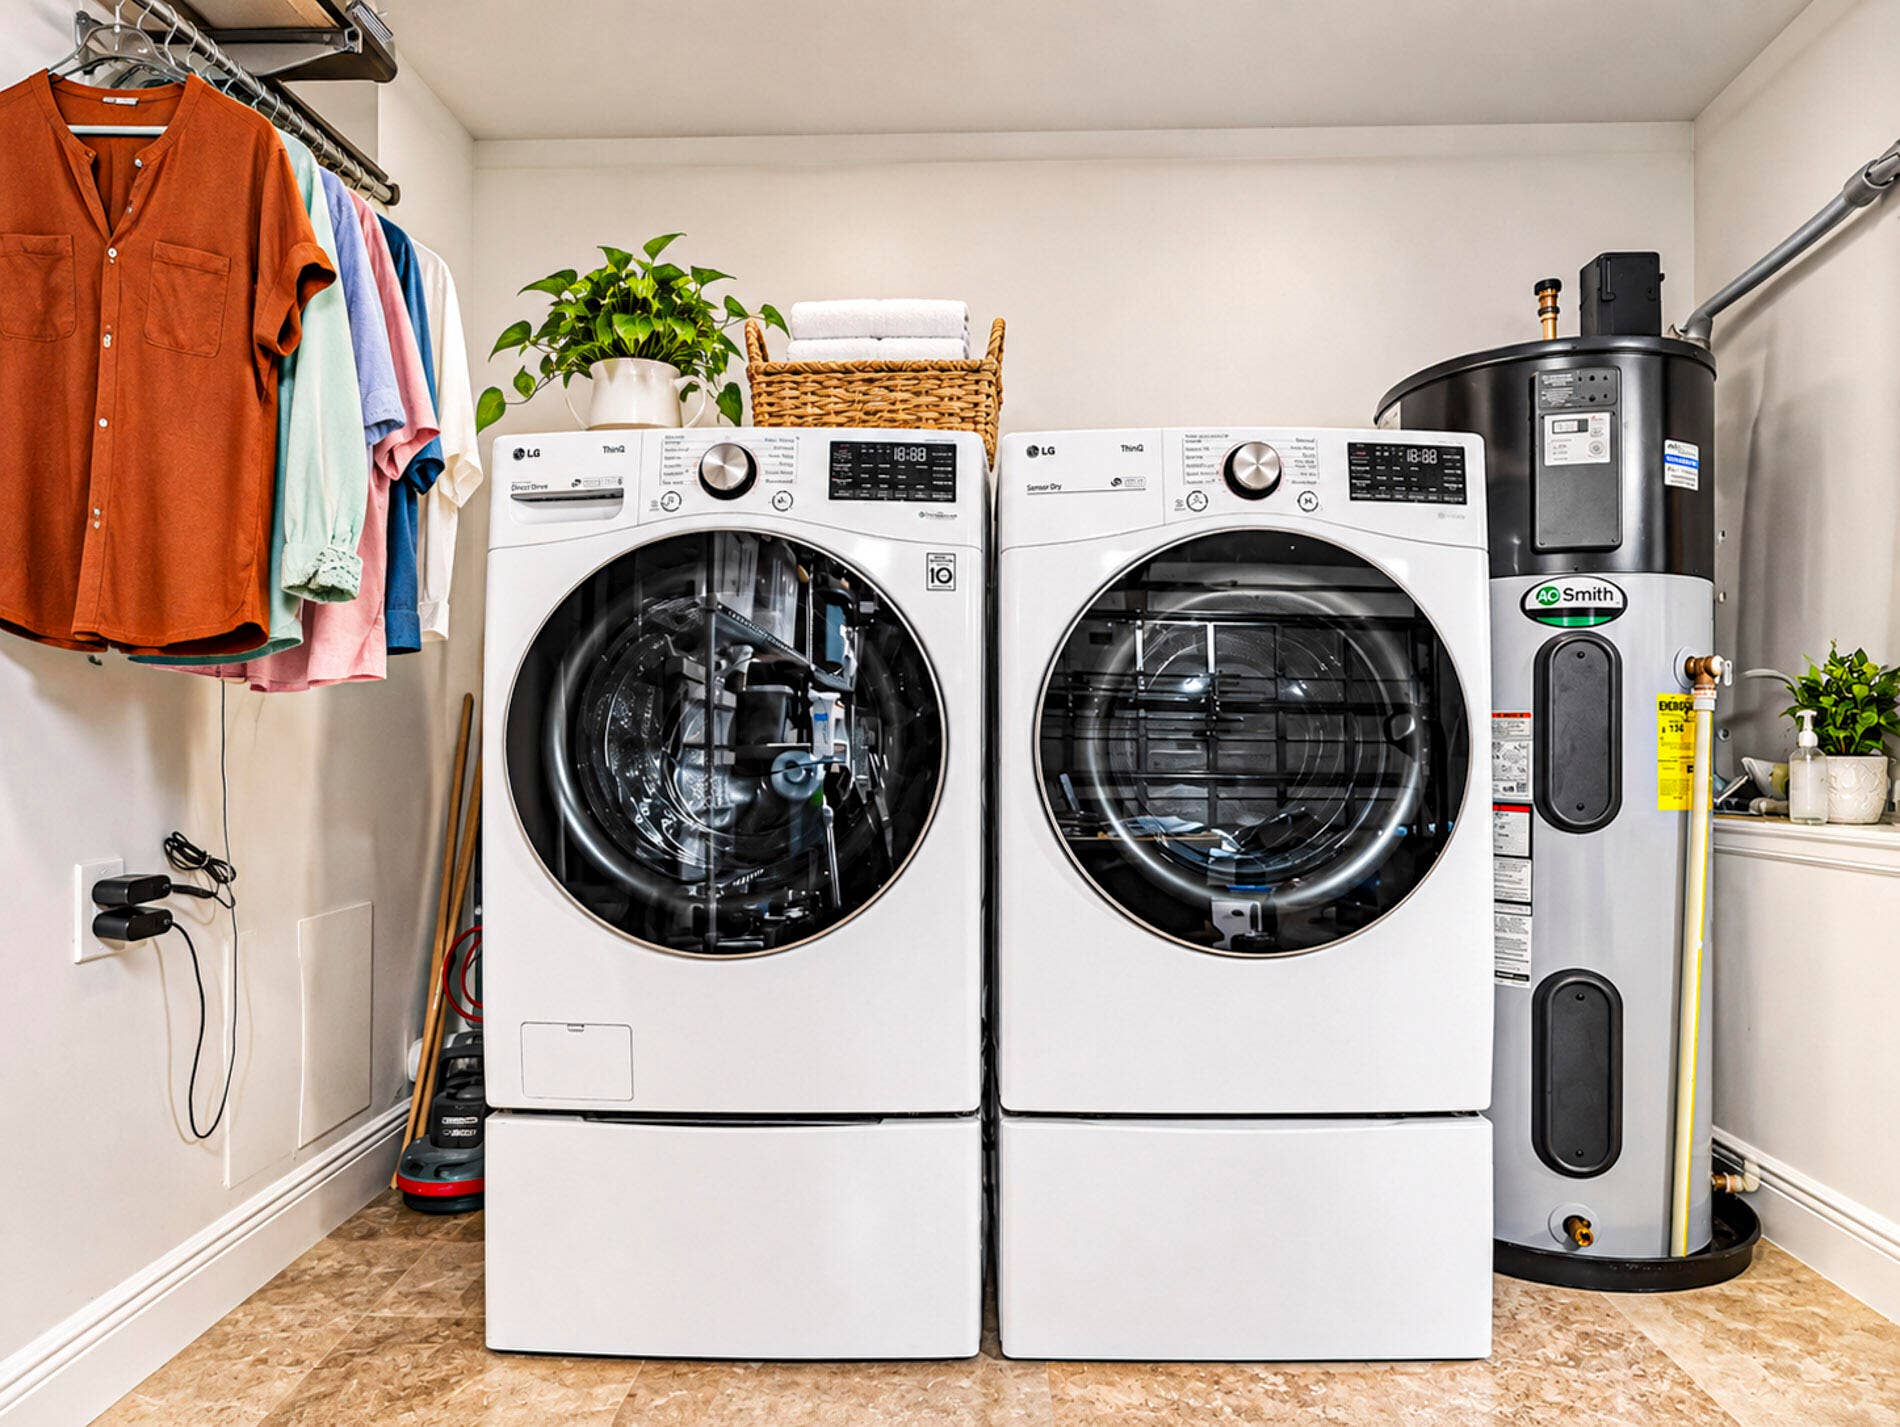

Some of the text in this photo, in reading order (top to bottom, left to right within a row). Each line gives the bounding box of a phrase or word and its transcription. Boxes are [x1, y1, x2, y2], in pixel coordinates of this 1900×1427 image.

[602, 445, 625, 454] ThinQ
[1041, 446, 1056, 456] LG
[1120, 443, 1144, 453] ThinQ
[527, 449, 541, 458] LG
[1050, 482, 1062, 491] Dry
[930, 567, 953, 584] 10
[1537, 587, 1614, 603] AO Smith
